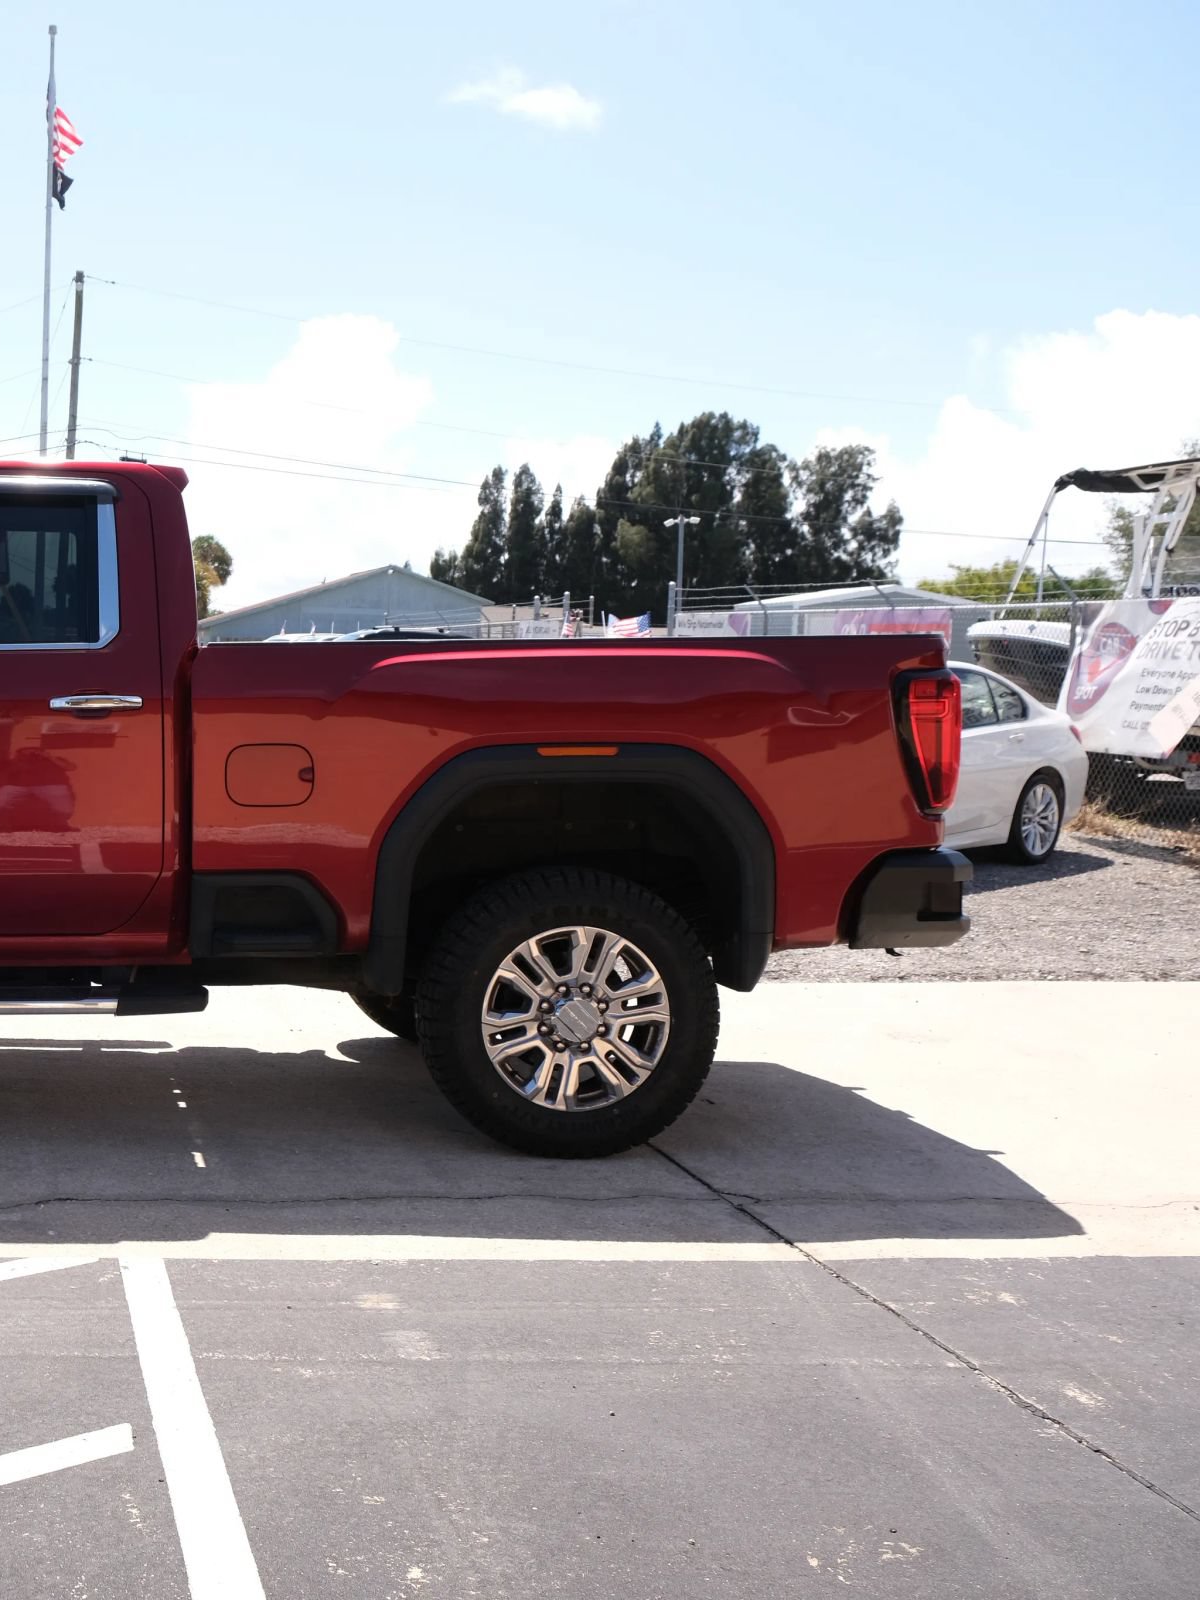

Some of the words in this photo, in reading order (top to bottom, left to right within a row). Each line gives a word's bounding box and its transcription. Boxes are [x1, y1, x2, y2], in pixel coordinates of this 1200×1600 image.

[1149, 620, 1190, 639] STOP
[1136, 641, 1186, 660] DRIVE
[1187, 641, 1200, 662] T
